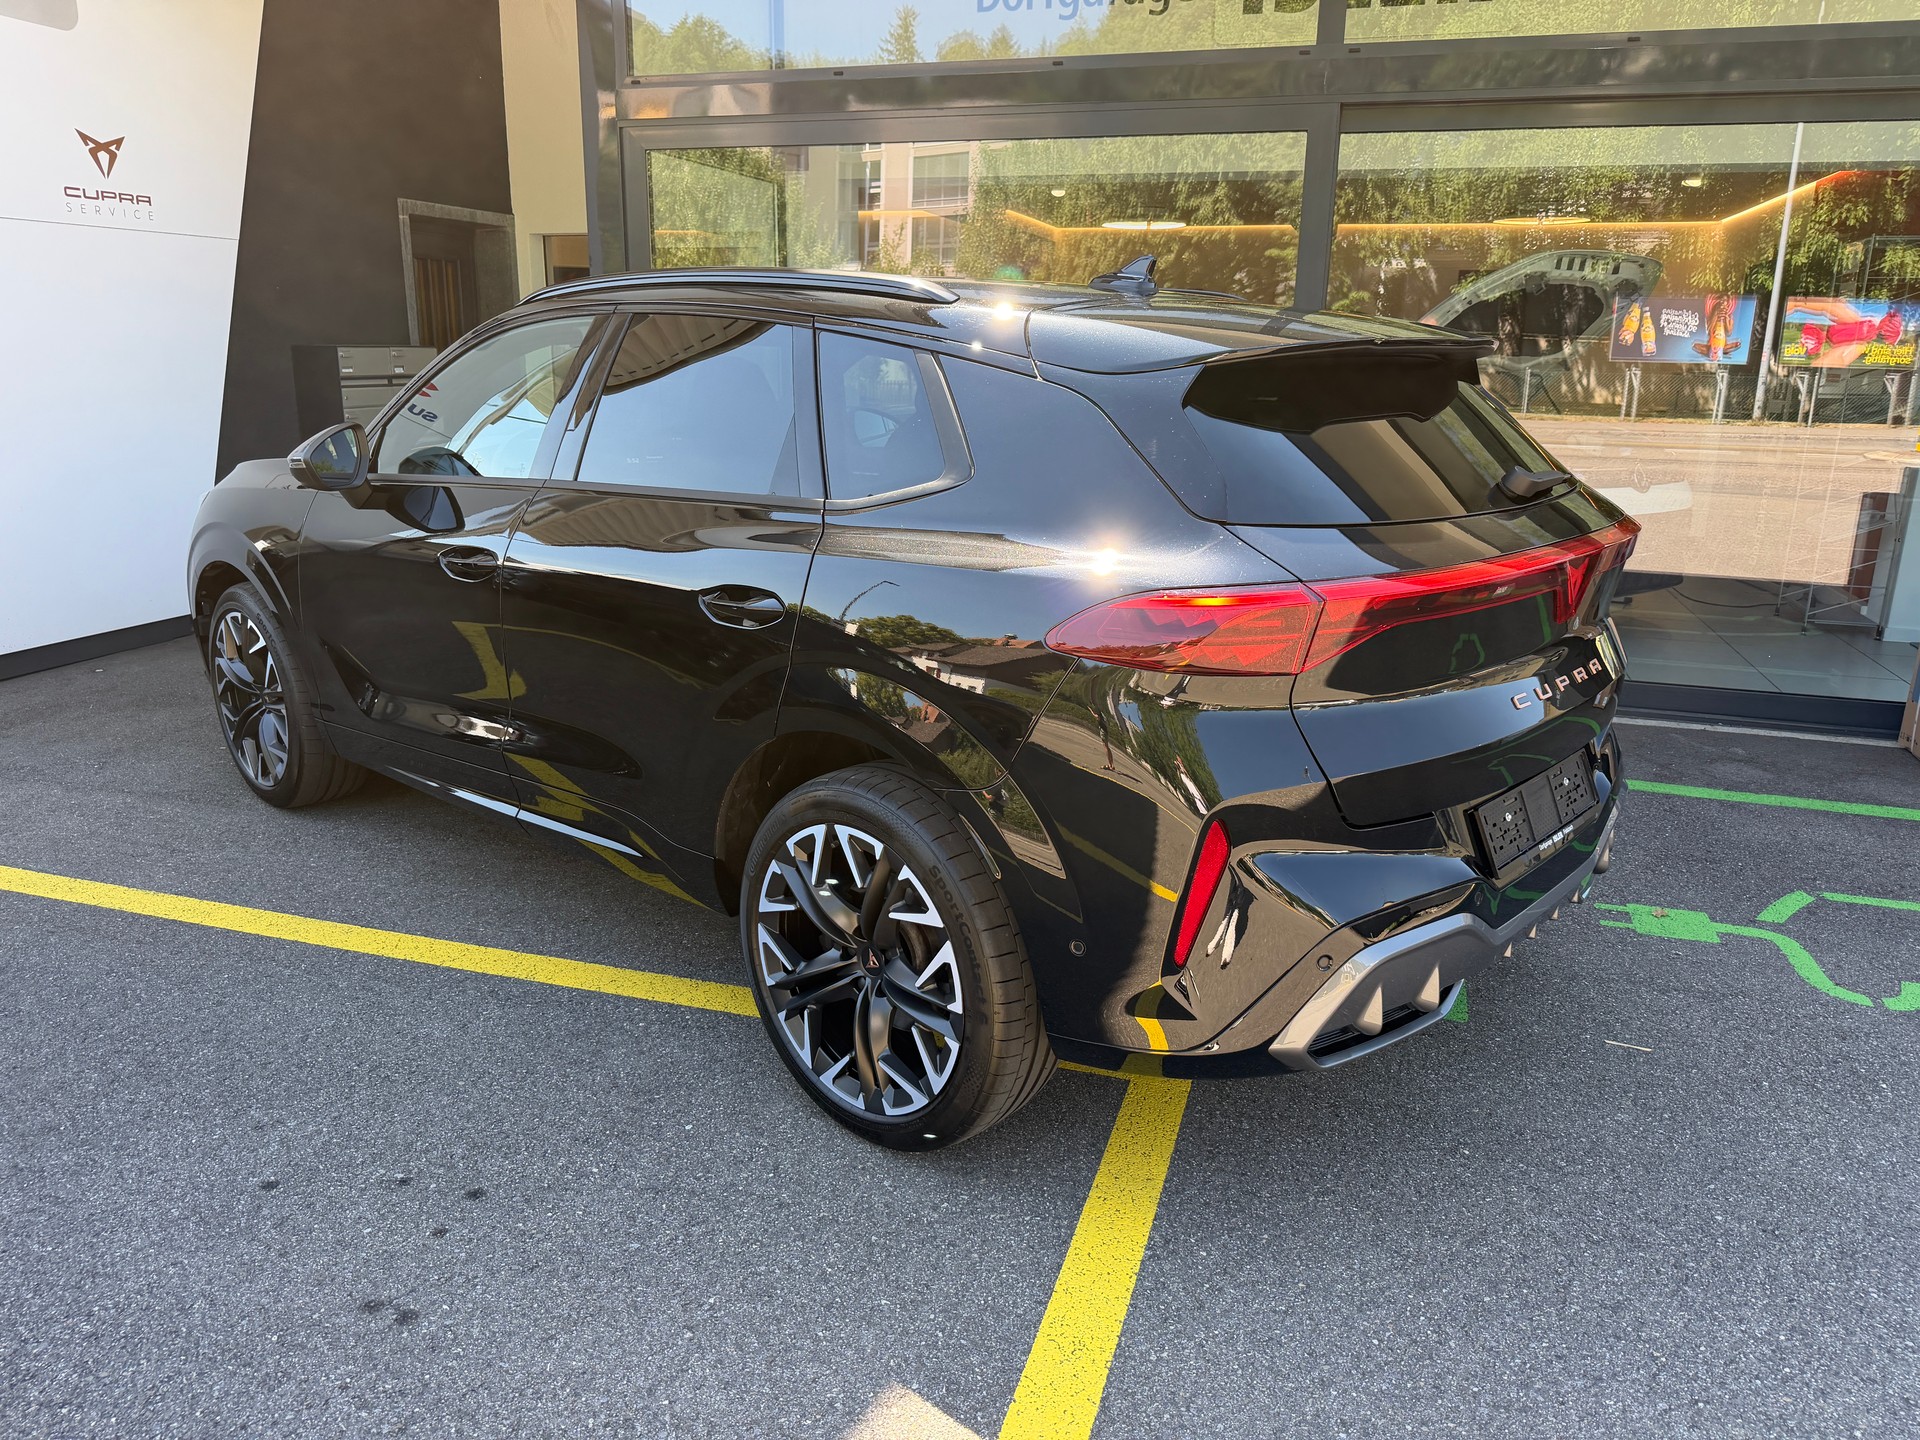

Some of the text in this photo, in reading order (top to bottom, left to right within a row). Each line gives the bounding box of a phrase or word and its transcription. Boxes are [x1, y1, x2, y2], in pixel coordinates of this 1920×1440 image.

[63, 186, 152, 206] CUPRA
[65, 202, 154, 221] SERVICE
[1511, 658, 1602, 710] CUPRA
[928, 865, 987, 1004] SportContact
